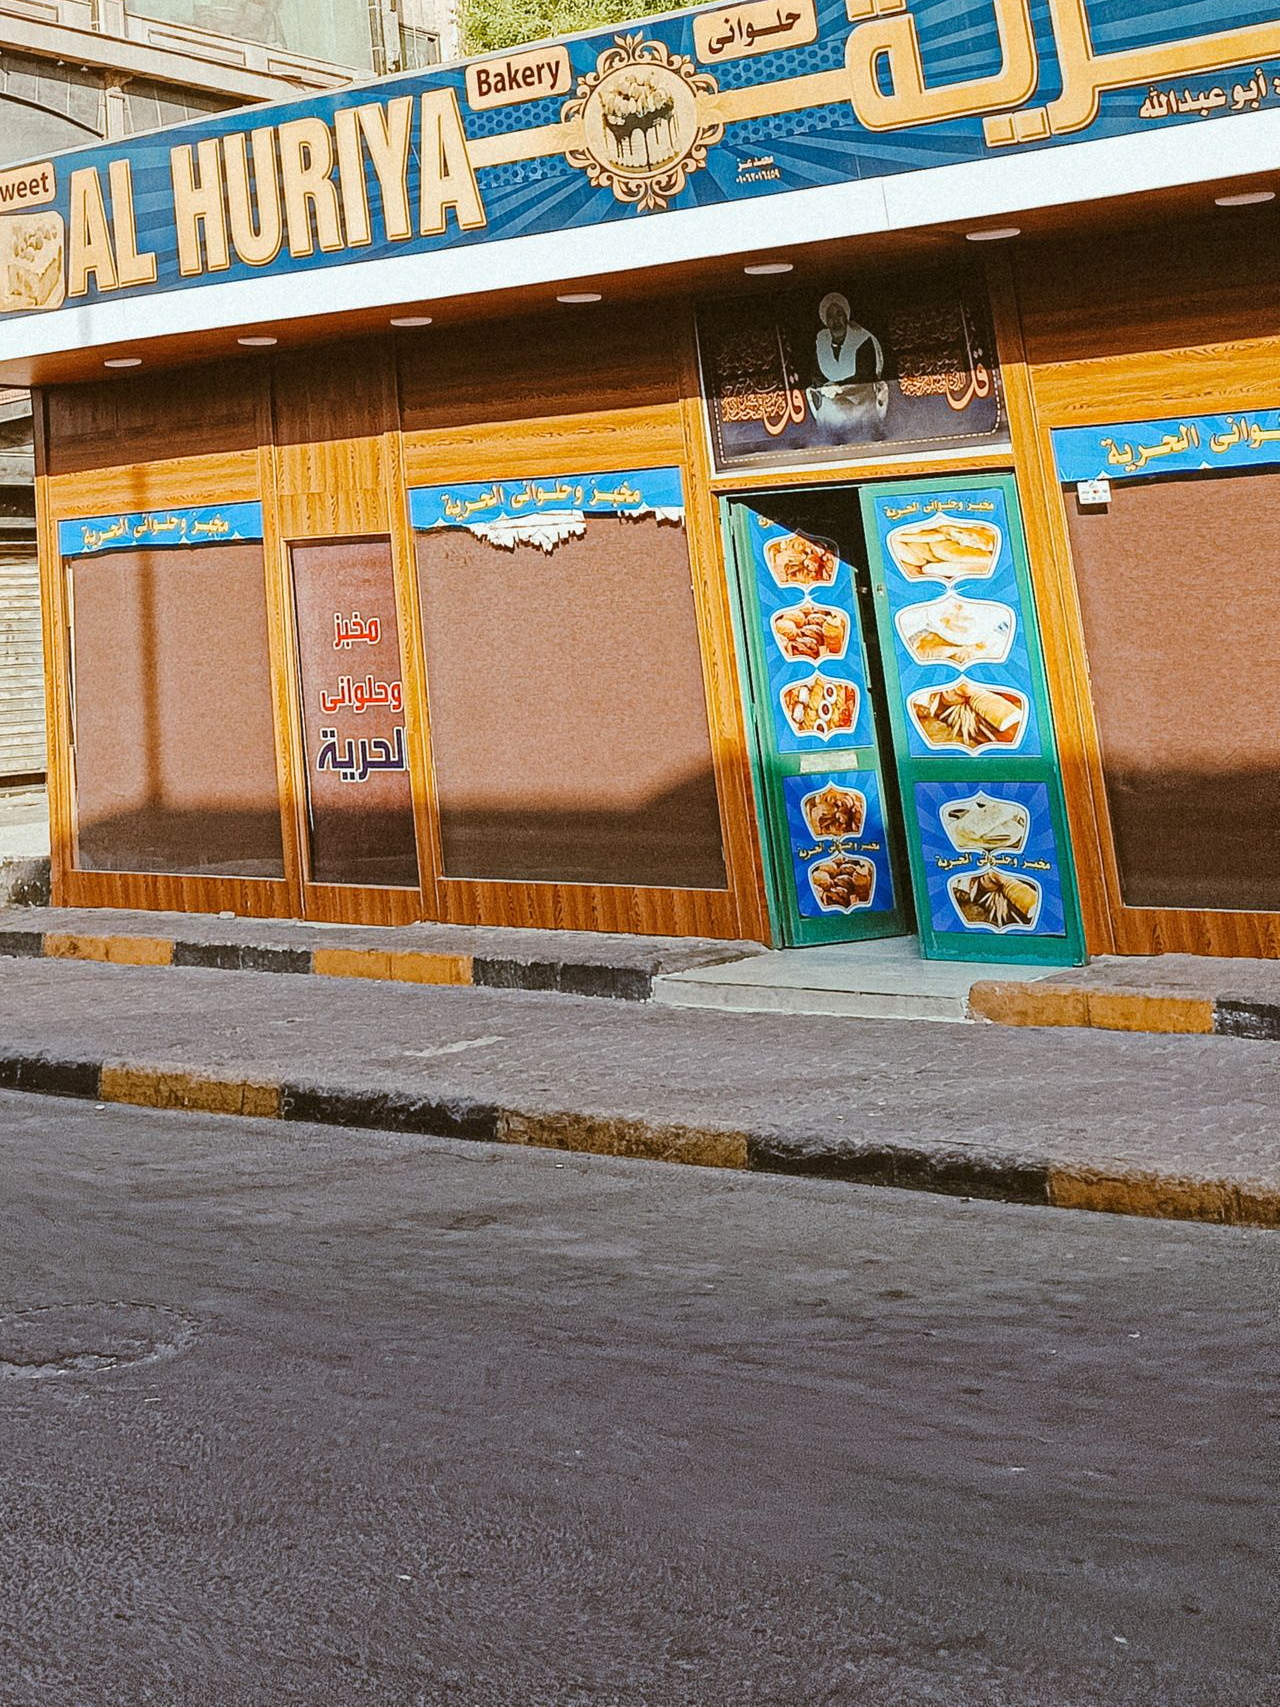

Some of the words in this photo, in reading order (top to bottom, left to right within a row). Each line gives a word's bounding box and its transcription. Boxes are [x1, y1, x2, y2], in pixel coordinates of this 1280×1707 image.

[475, 57, 562, 98] Bakery
[1229, 67, 1267, 110] أبو
[68, 158, 158, 297] AL
[170, 87, 488, 278] HURIYA
[1100, 422, 1200, 472] الحرية
[1210, 415, 1280, 454] وانى
[441, 484, 505, 522] الحرية
[590, 477, 642, 509] مخبز
[80, 515, 129, 551] الحرية
[190, 511, 230, 537] مخبز
[333, 611, 381, 650] مخبز
[320, 675, 404, 714] وحلوانى
[317, 726, 410, 782] لحرية
